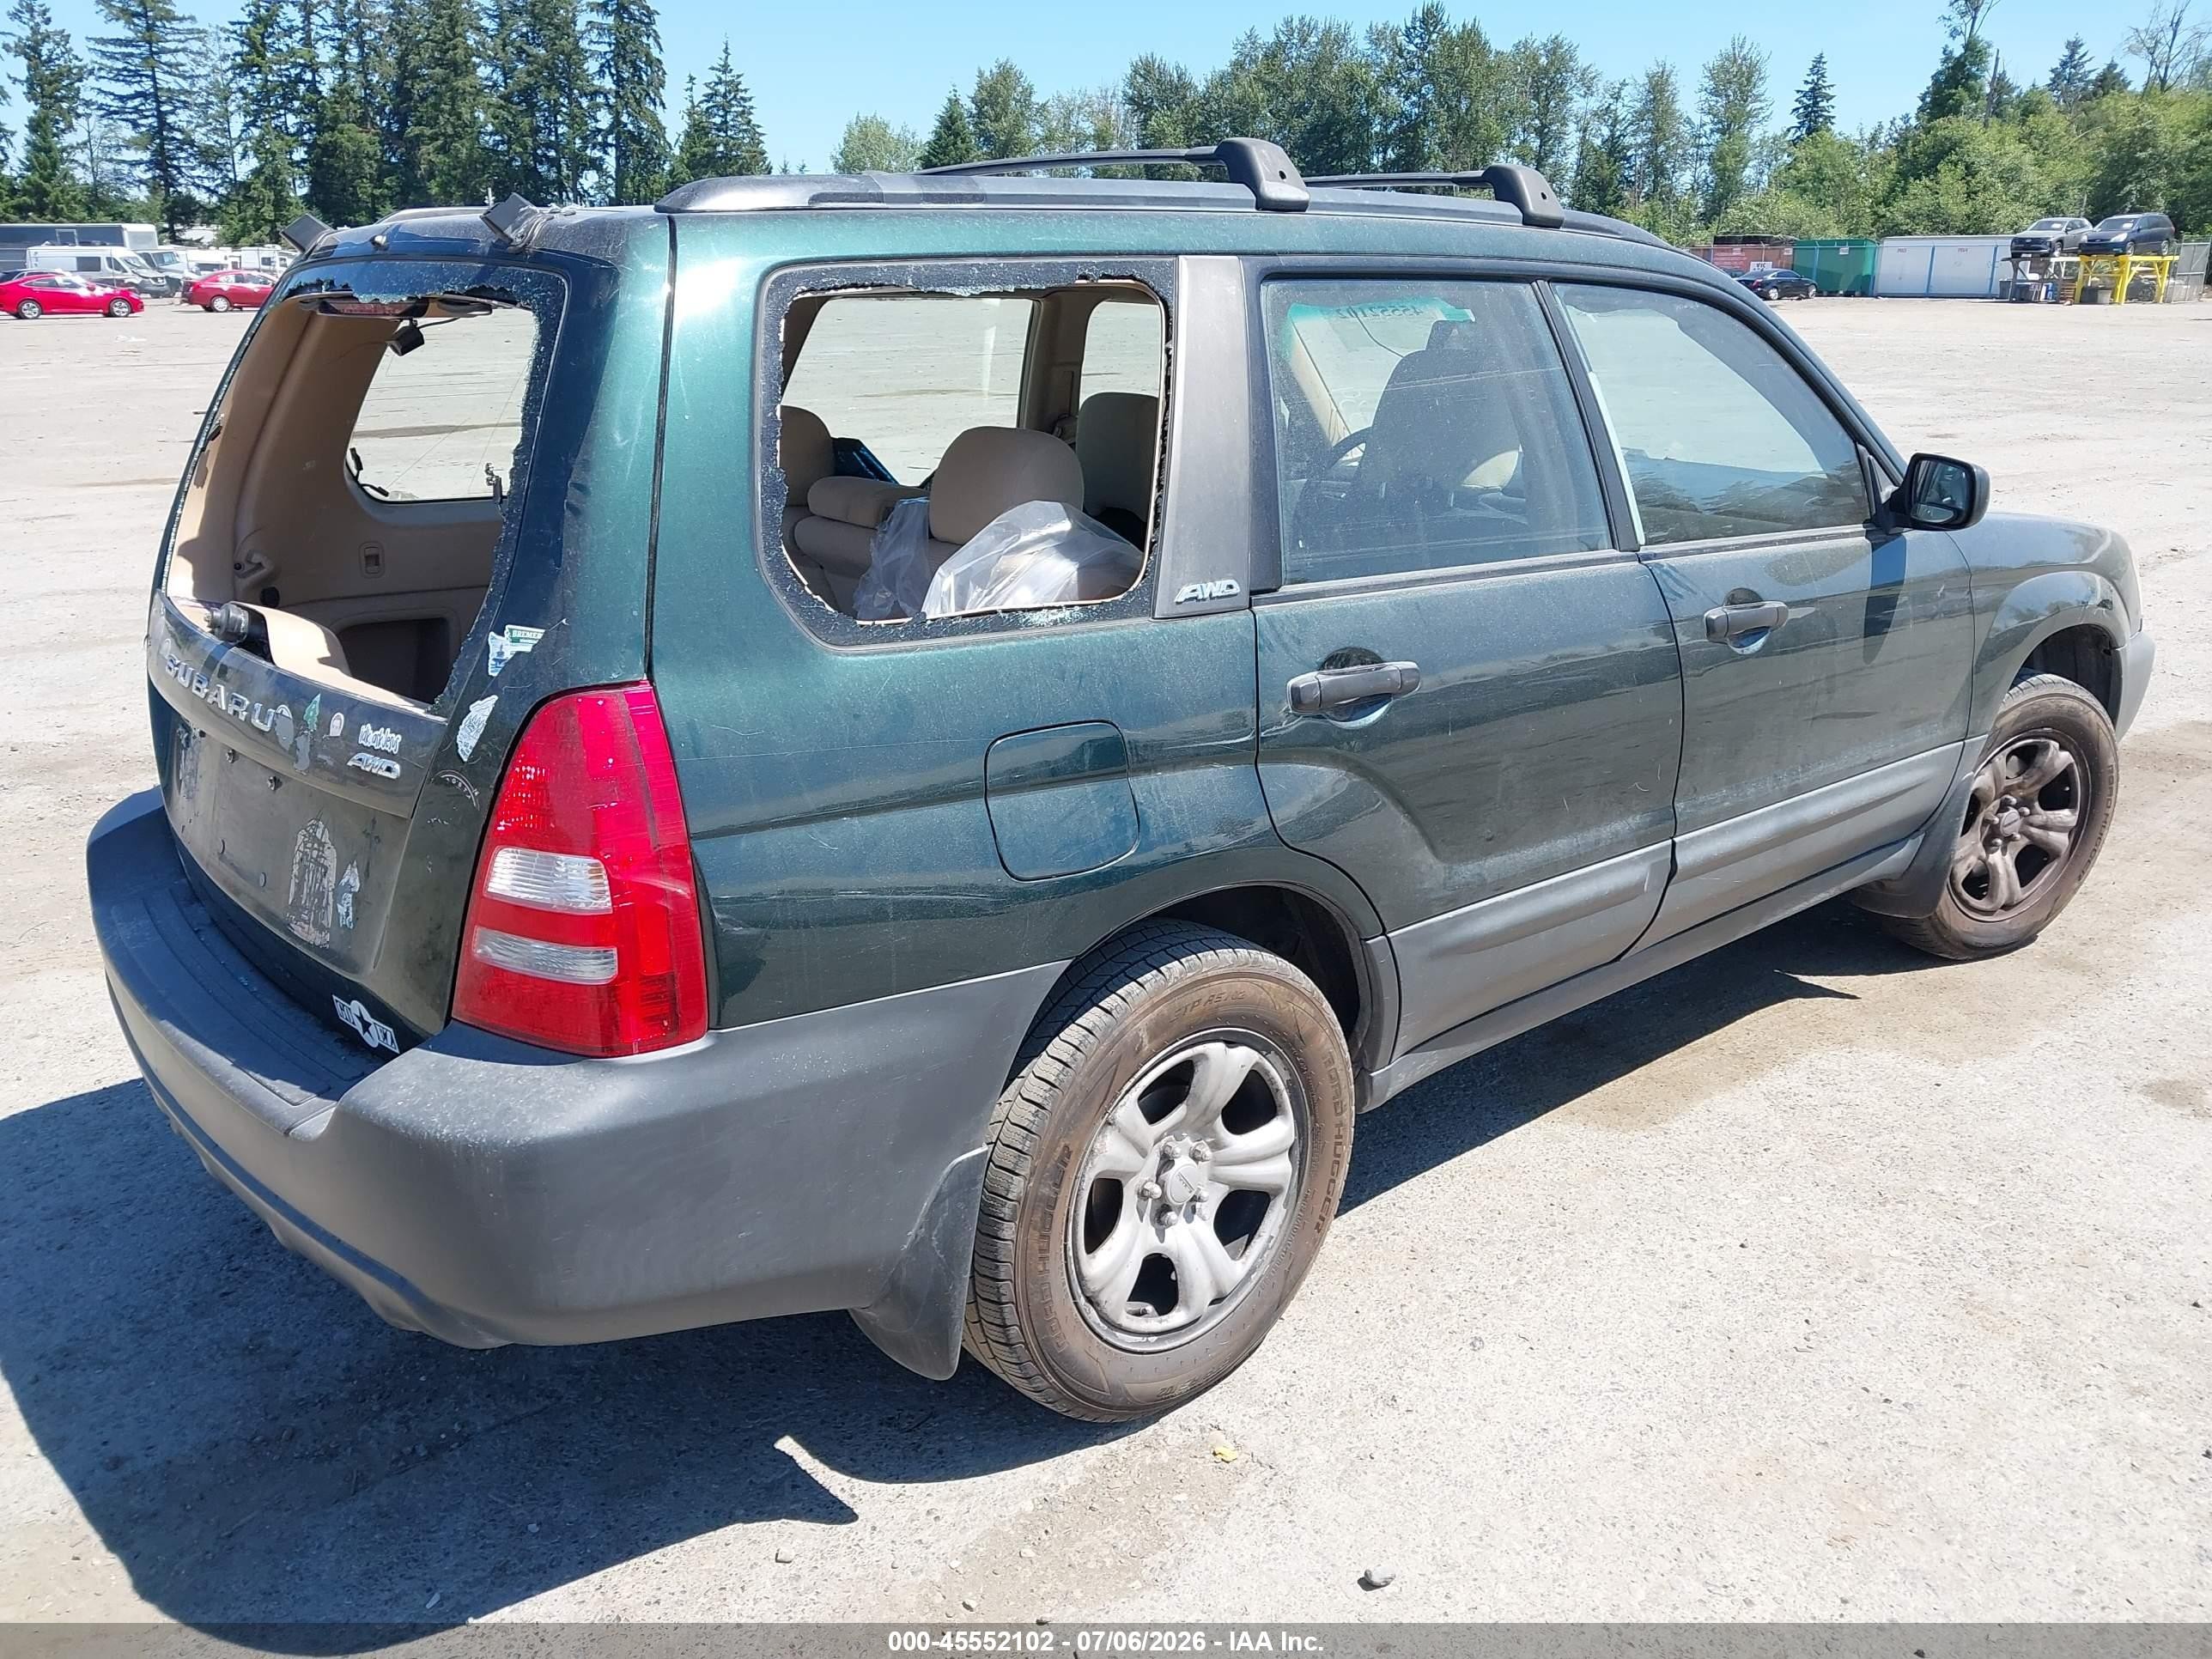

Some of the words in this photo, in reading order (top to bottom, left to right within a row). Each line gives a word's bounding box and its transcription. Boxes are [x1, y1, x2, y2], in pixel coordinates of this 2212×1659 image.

[1174, 580, 1241, 603] AWD
[166, 653, 276, 732] SUBARU
[347, 752, 400, 779] AWD
[1315, 1122, 1343, 1233] HUGGER
